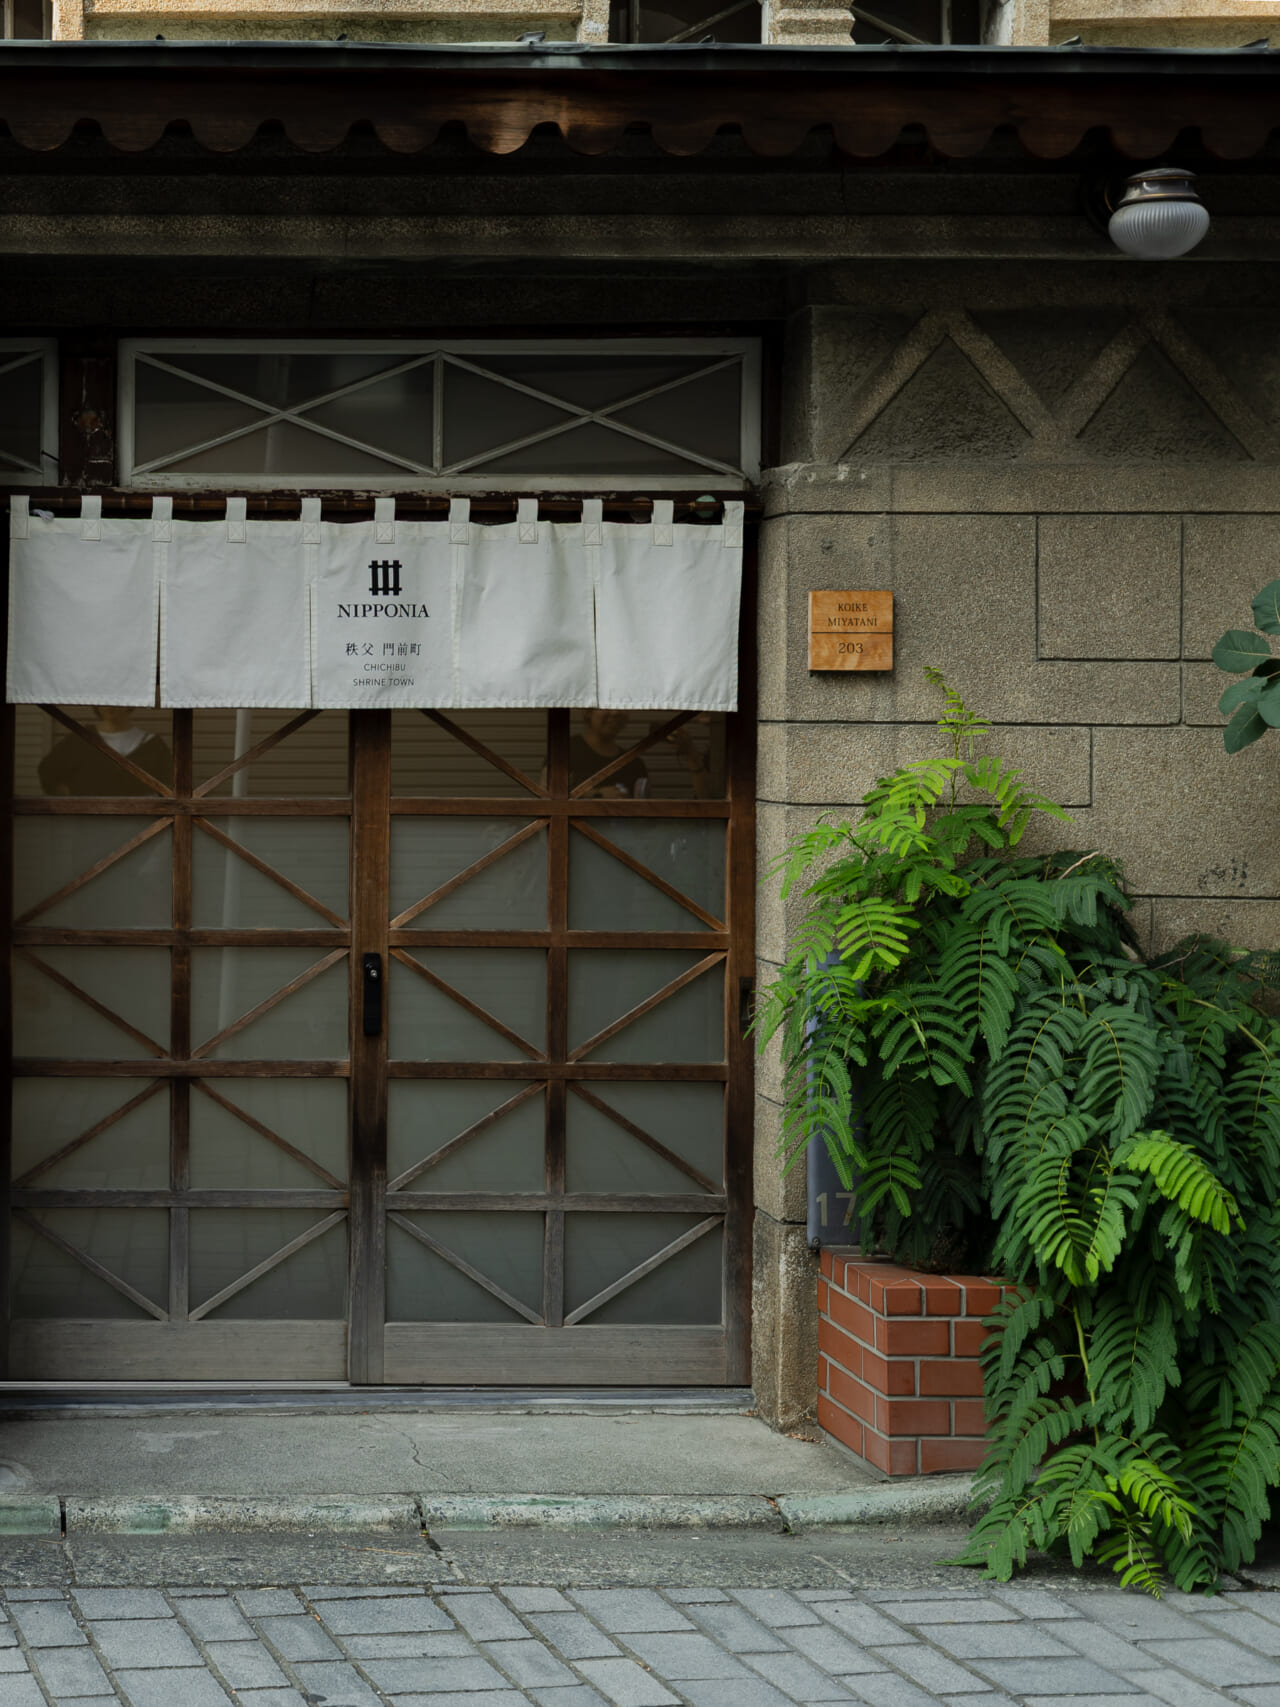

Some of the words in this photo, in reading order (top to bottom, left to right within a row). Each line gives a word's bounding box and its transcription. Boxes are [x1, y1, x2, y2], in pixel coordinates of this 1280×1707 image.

[337, 604, 430, 618] NIPPONIA
[838, 603, 869, 612] KOIKE
[827, 617, 878, 627] MIYATANI
[345, 643, 374, 656] 秩父
[383, 643, 422, 656] 門前町
[838, 642, 864, 654] 203
[363, 663, 406, 672] CHICHIBU
[352, 678, 386, 687] SHRINE
[388, 678, 415, 687] TOWN
[815, 1192, 857, 1227] 17
